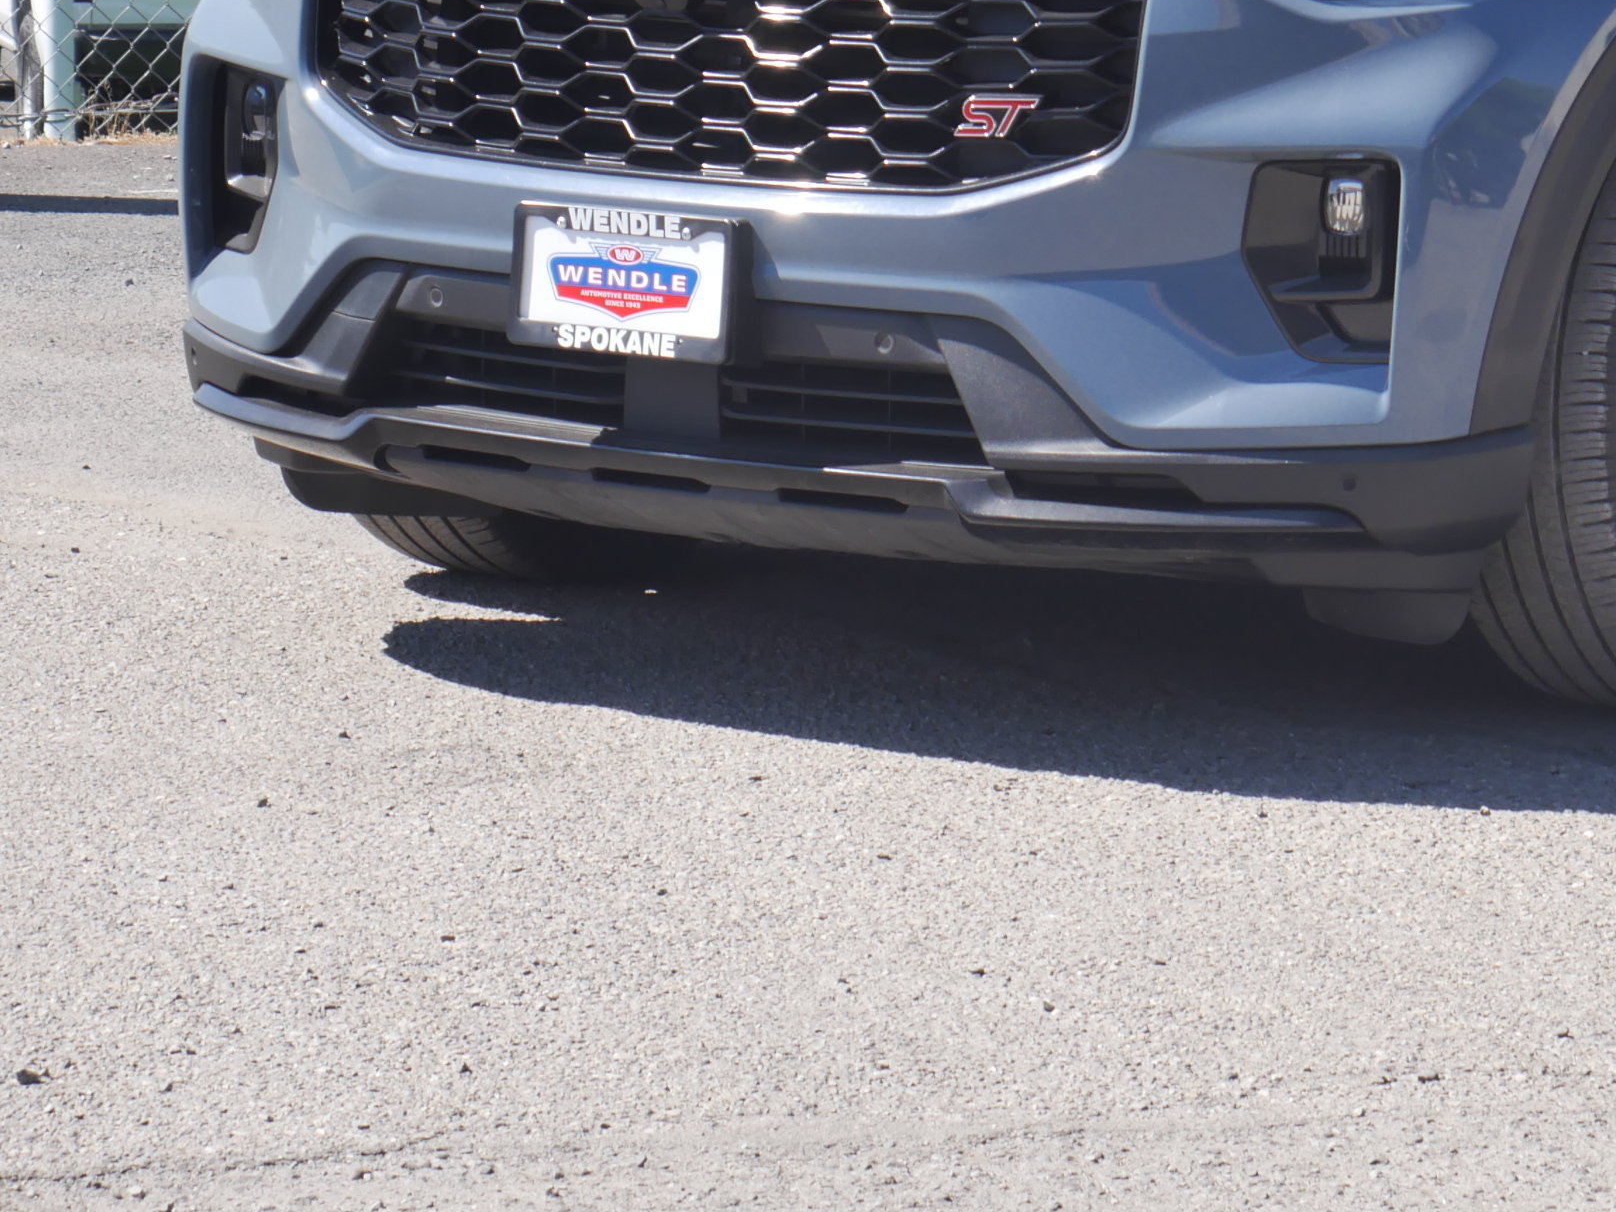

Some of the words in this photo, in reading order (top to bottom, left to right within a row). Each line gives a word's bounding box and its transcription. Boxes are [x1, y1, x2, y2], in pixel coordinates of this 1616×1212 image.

[953, 94, 1041, 137] ST
[568, 207, 682, 240] WENDLE
[613, 248, 636, 262] W
[557, 264, 688, 293] WENDLE
[580, 289, 622, 300] AUTOMOTIVE
[623, 293, 664, 303] EXCELLENCE
[604, 299, 625, 307] SINCE
[557, 324, 676, 358] SPOKANE
